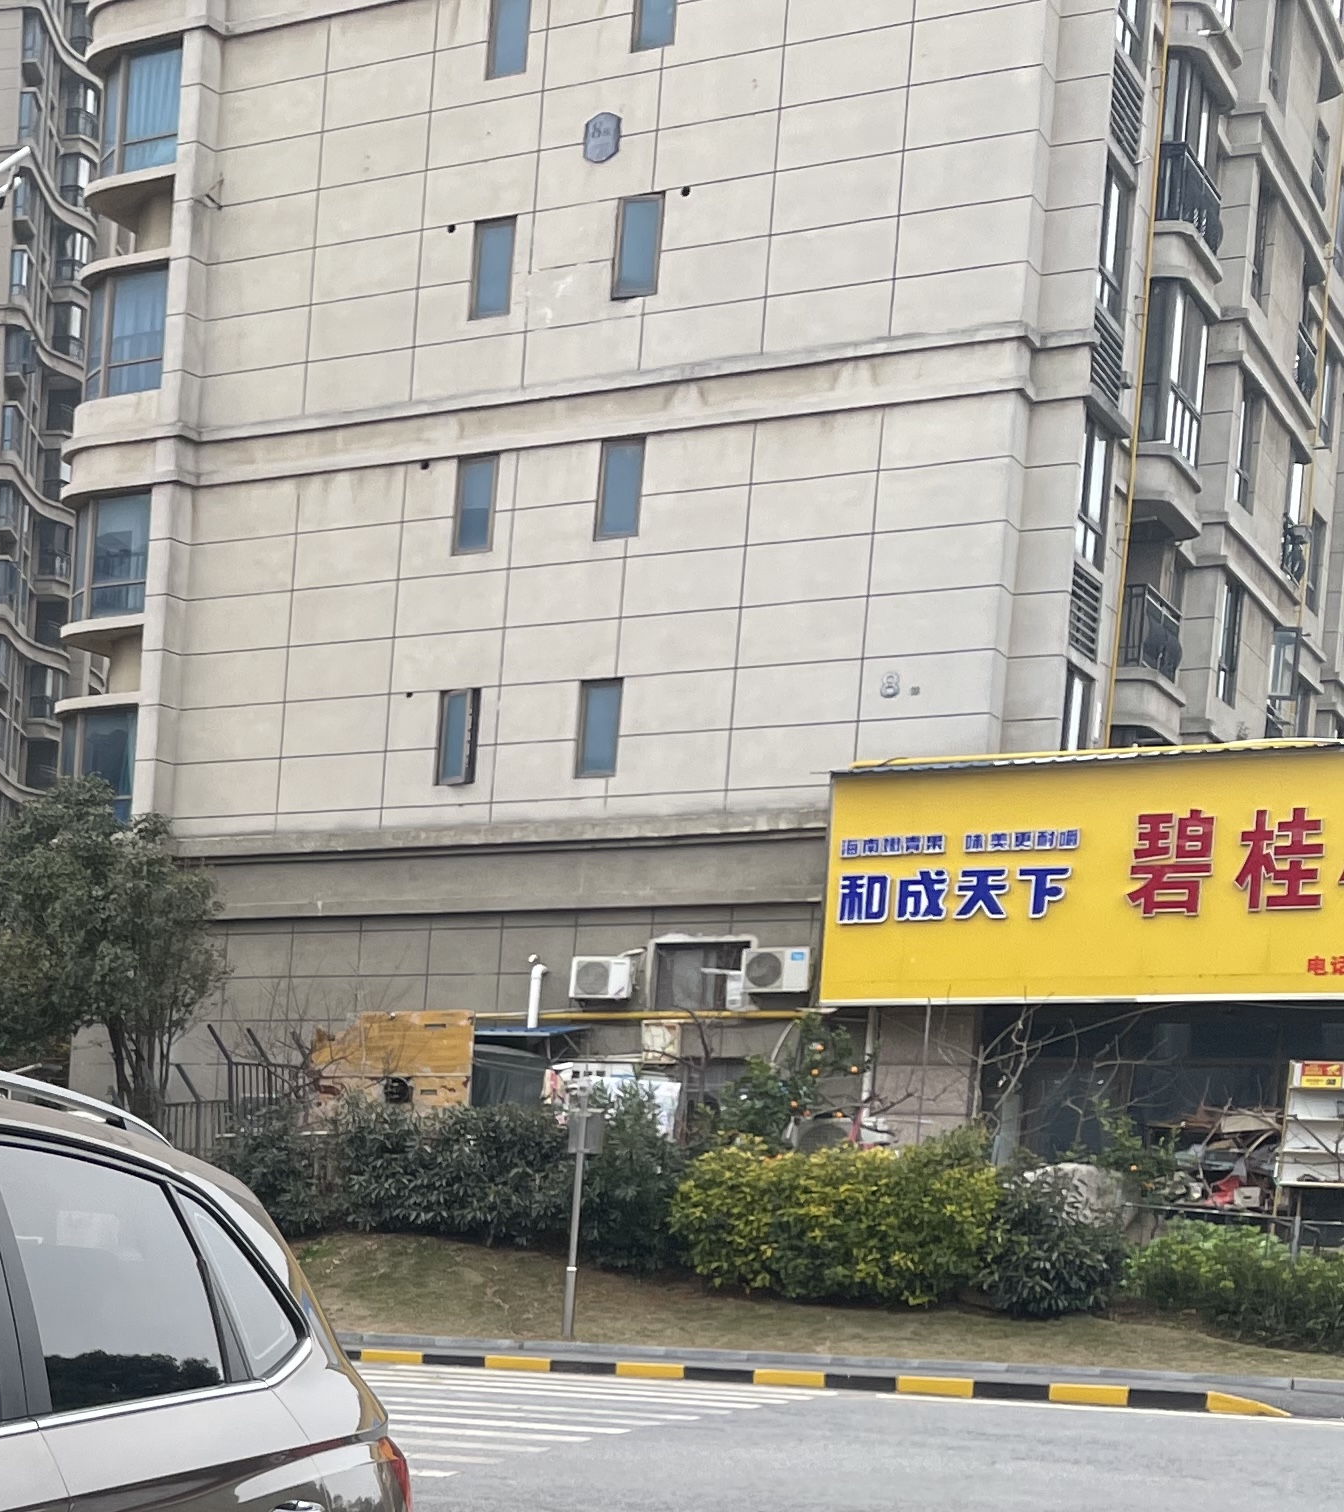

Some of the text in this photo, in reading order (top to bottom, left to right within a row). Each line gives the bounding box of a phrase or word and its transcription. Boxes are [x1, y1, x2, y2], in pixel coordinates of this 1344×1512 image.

[838, 867, 1072, 924] 和成天下
[1126, 807, 1344, 917] 碧桂
